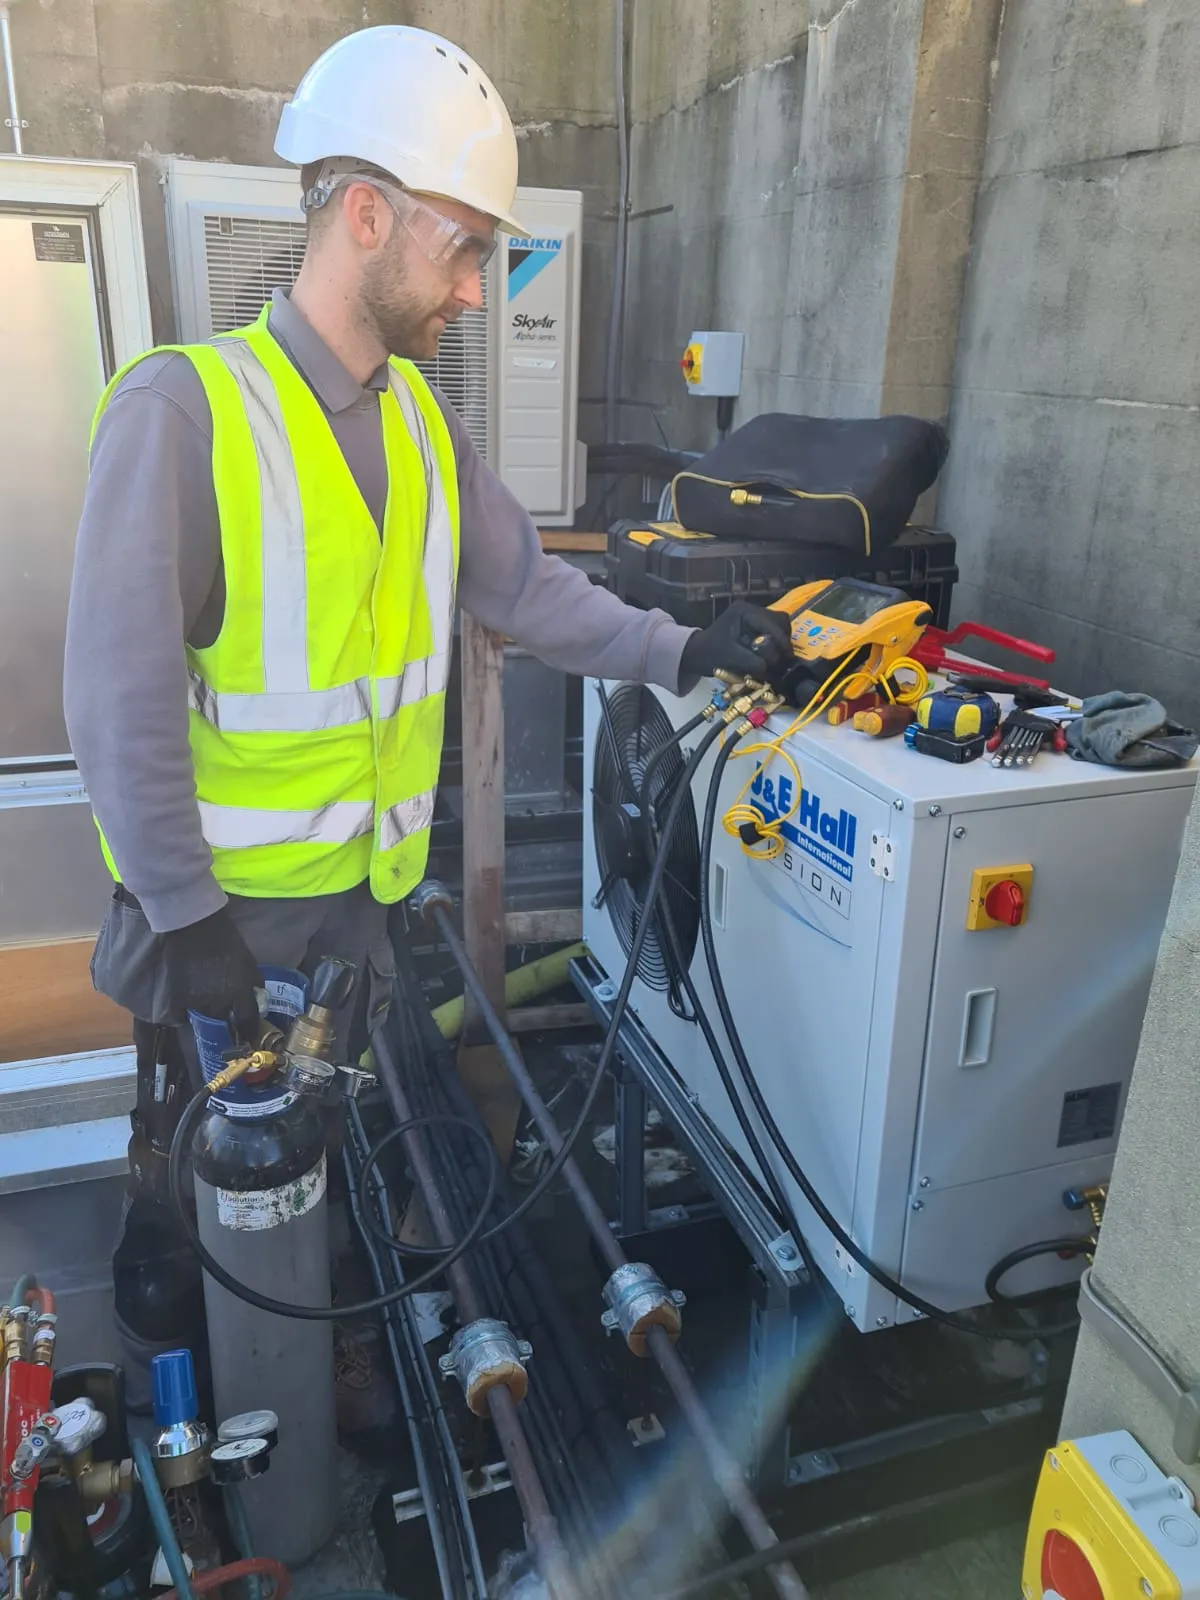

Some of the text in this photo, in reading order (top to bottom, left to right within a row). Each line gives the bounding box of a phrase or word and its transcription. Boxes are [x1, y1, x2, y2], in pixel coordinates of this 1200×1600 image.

[508, 237, 562, 250] DAIKIN
[751, 760, 857, 858] J&E Hall
[797, 832, 852, 878] International
